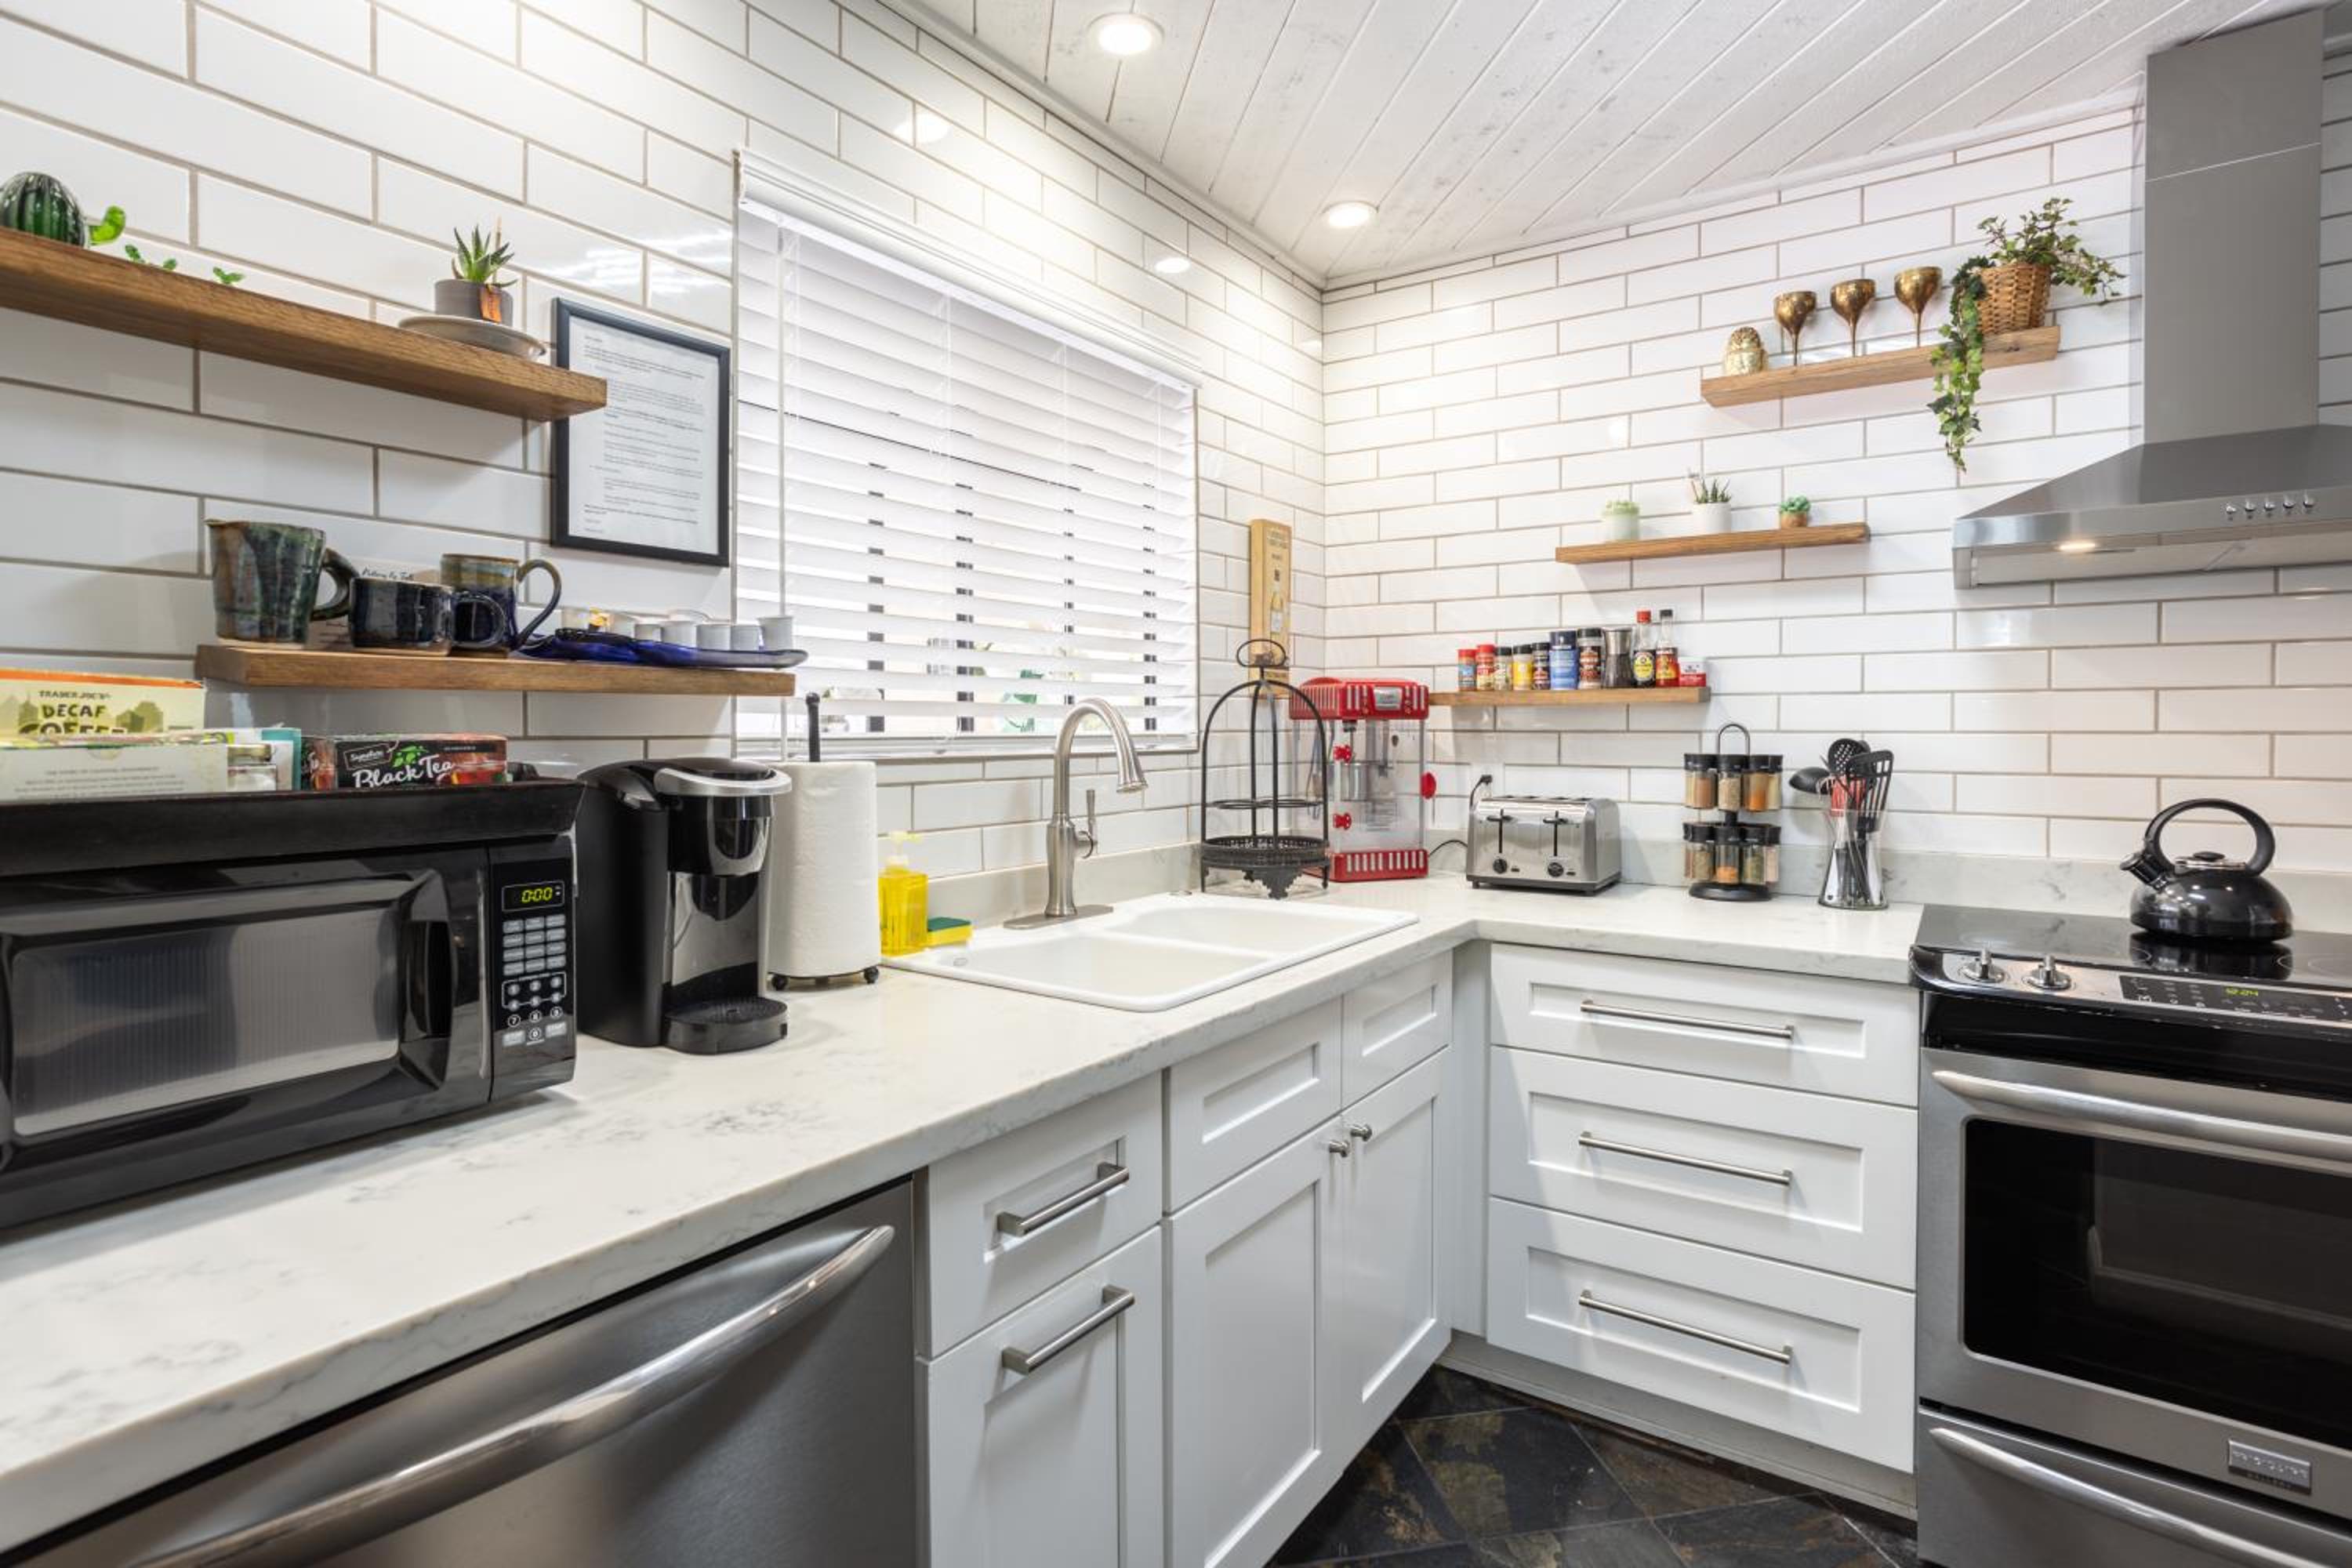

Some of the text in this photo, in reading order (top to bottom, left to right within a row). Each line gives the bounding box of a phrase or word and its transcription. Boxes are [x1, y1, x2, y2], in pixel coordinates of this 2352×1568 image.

[42, 703, 106, 718] DECAF
[20, 722, 125, 734] OFF
[352, 753, 455, 788] Black Tea
[521, 887, 553, 902] 0:00
